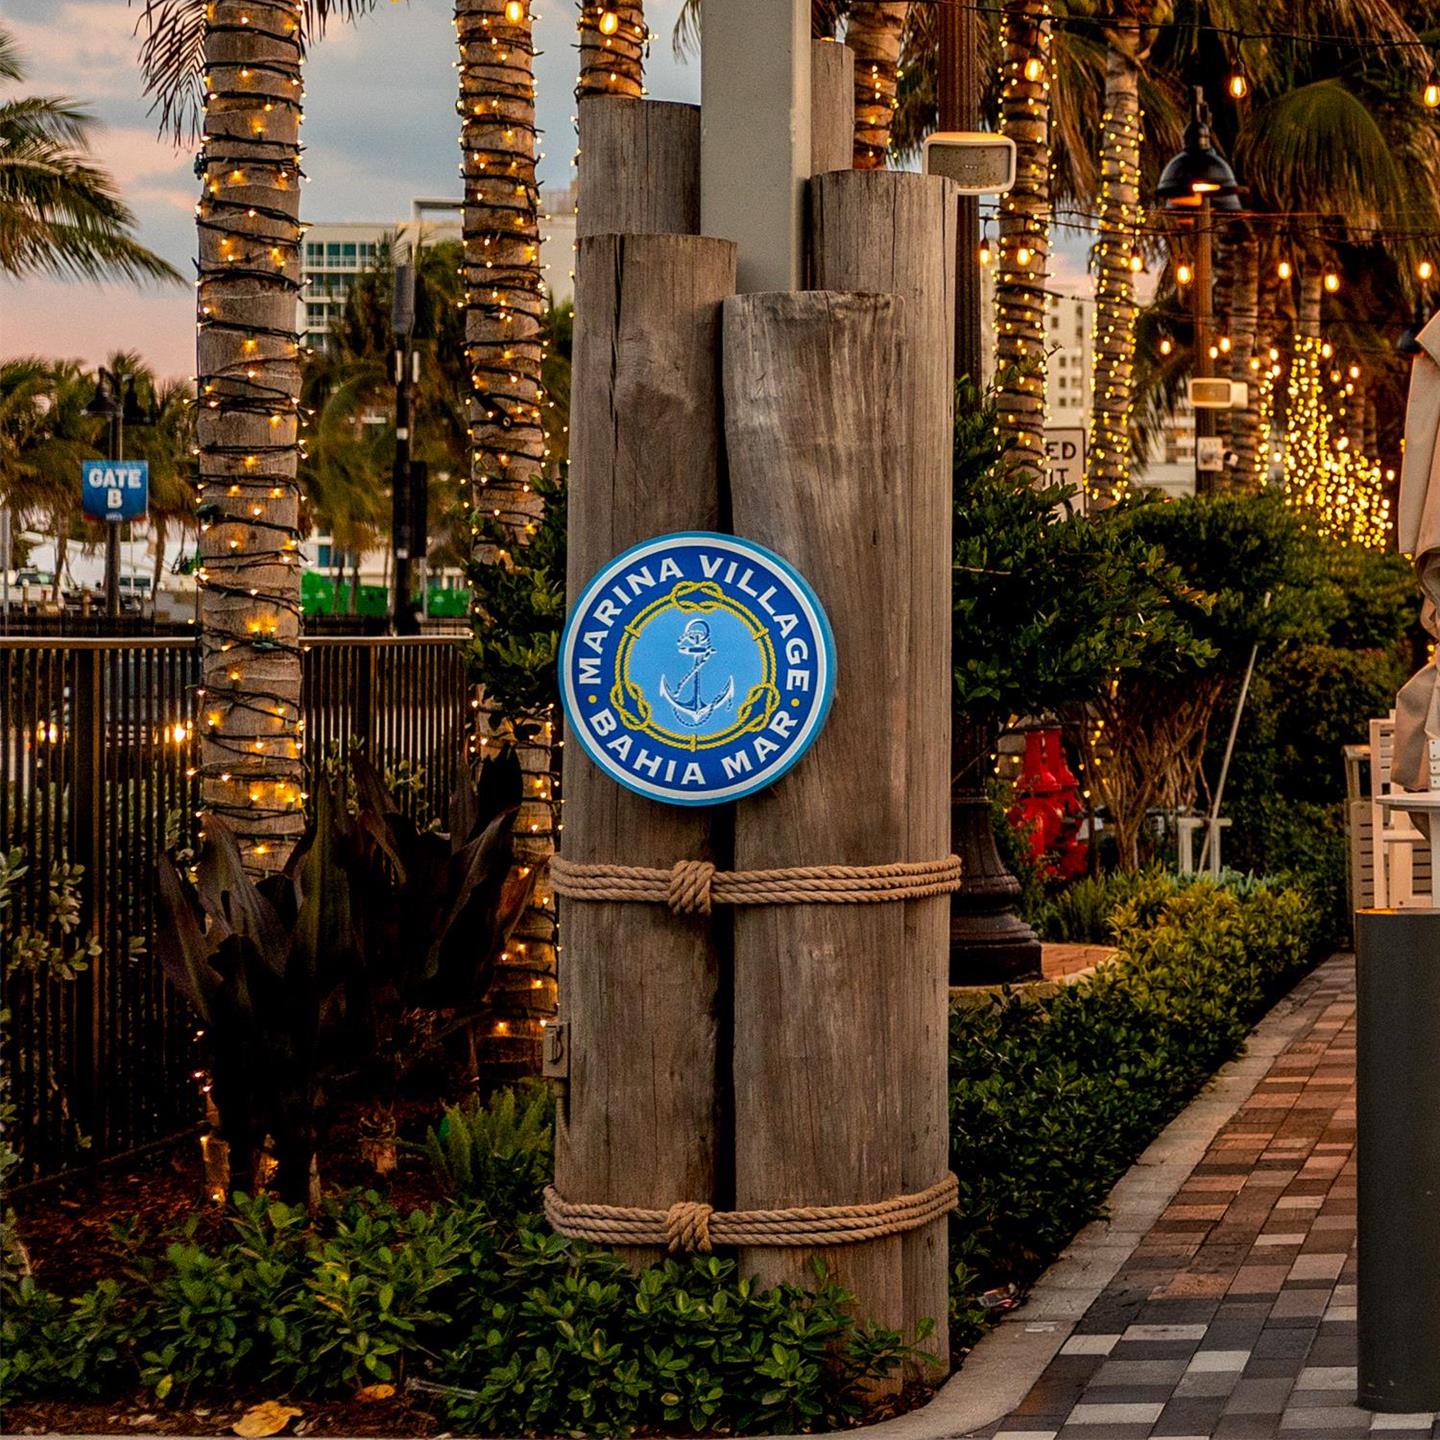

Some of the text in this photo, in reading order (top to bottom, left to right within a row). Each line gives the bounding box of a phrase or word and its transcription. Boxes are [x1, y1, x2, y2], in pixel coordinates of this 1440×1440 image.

[88, 467, 142, 489] GATE
[107, 488, 123, 509] B
[578, 554, 810, 692] MARINA VILLAGE
[588, 707, 798, 785] BAHIA MAR
